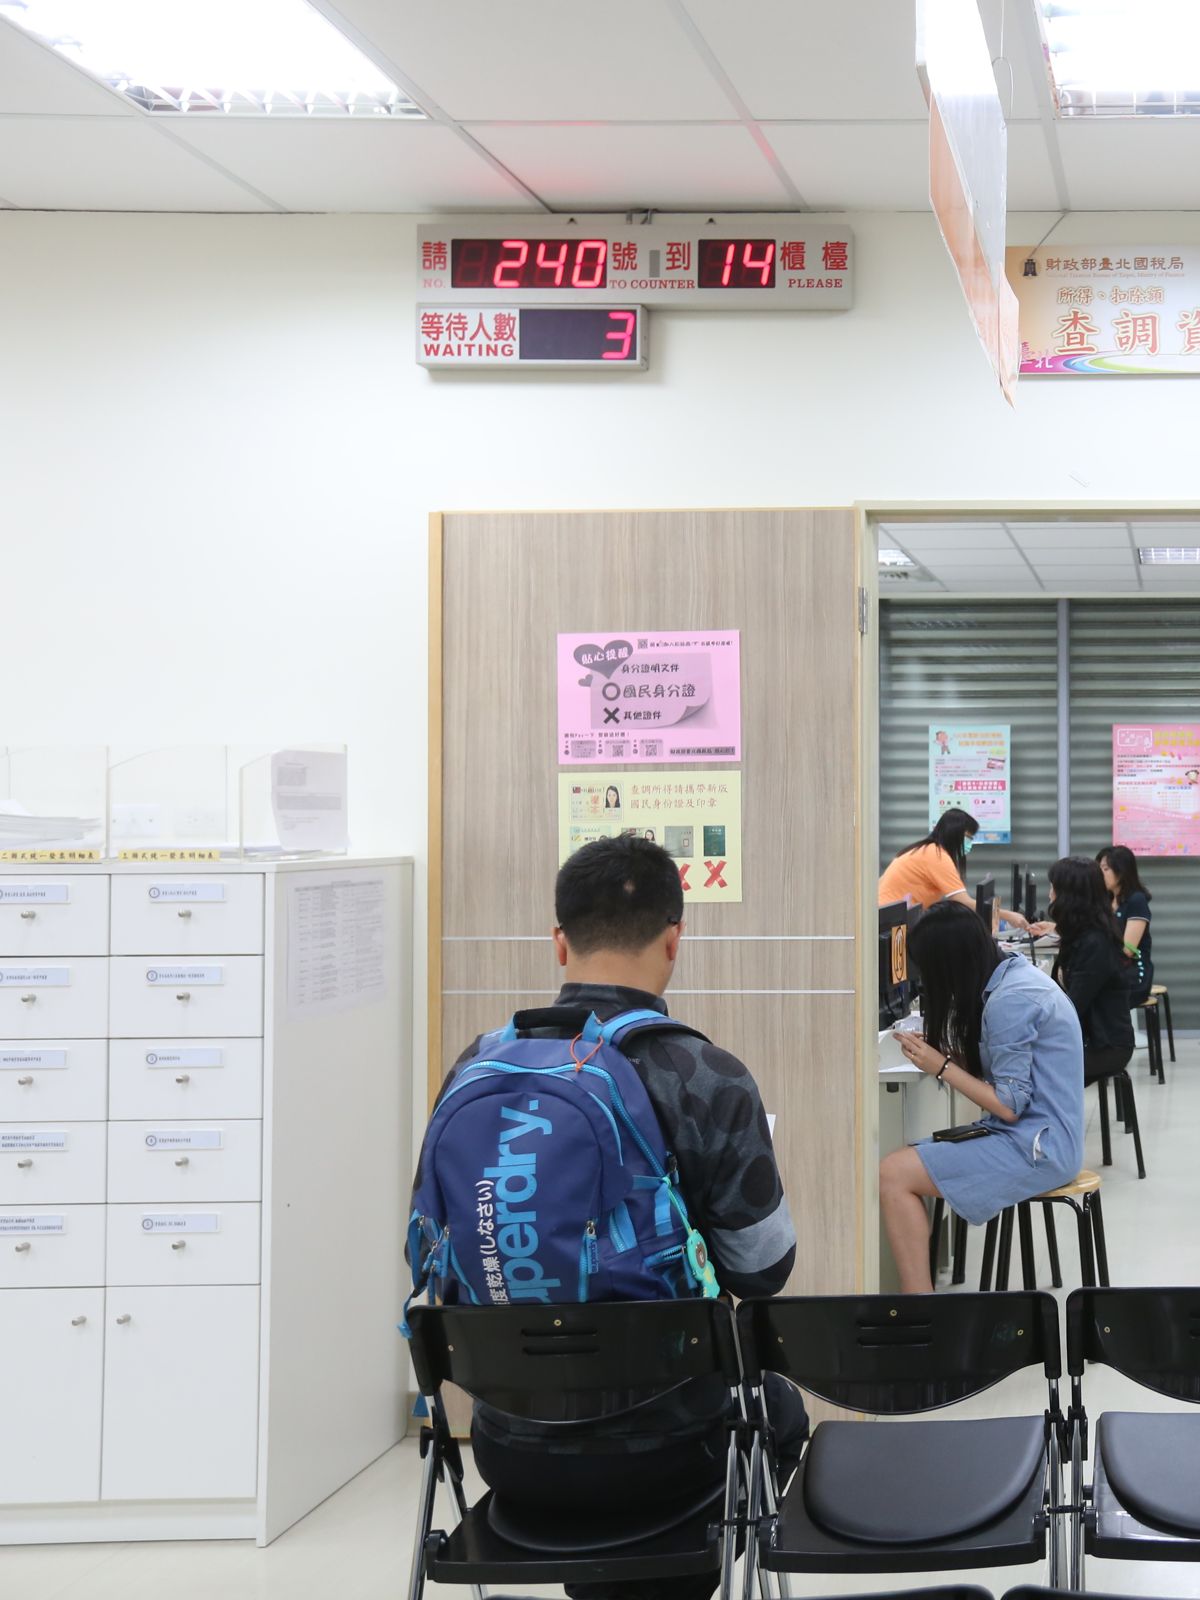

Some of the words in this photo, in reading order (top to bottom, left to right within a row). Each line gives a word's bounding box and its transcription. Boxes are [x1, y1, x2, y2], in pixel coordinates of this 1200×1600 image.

[422, 241, 448, 271] 請
[493, 240, 607, 288] 240
[612, 241, 638, 271] 號
[666, 241, 692, 271] 到
[721, 243, 775, 286] 14
[1045, 256, 1185, 271] 財政部臺北國稅局
[423, 278, 447, 289] NO.
[609, 279, 627, 289] TO
[630, 279, 695, 289] COUNTER
[788, 278, 843, 288] PLEASE
[1057, 285, 1165, 305] 所得、扣除額
[421, 312, 517, 342] 等待人數
[601, 311, 636, 359] 3
[423, 343, 515, 358] WAITING
[581, 646, 630, 665] 貼心提醒
[620, 663, 680, 674] 身分證明文件
[622, 683, 697, 699] 國民身分證
[623, 710, 662, 721] 其他證件
[475, 1179, 511, 1305] 度乾燥(しなさい)
